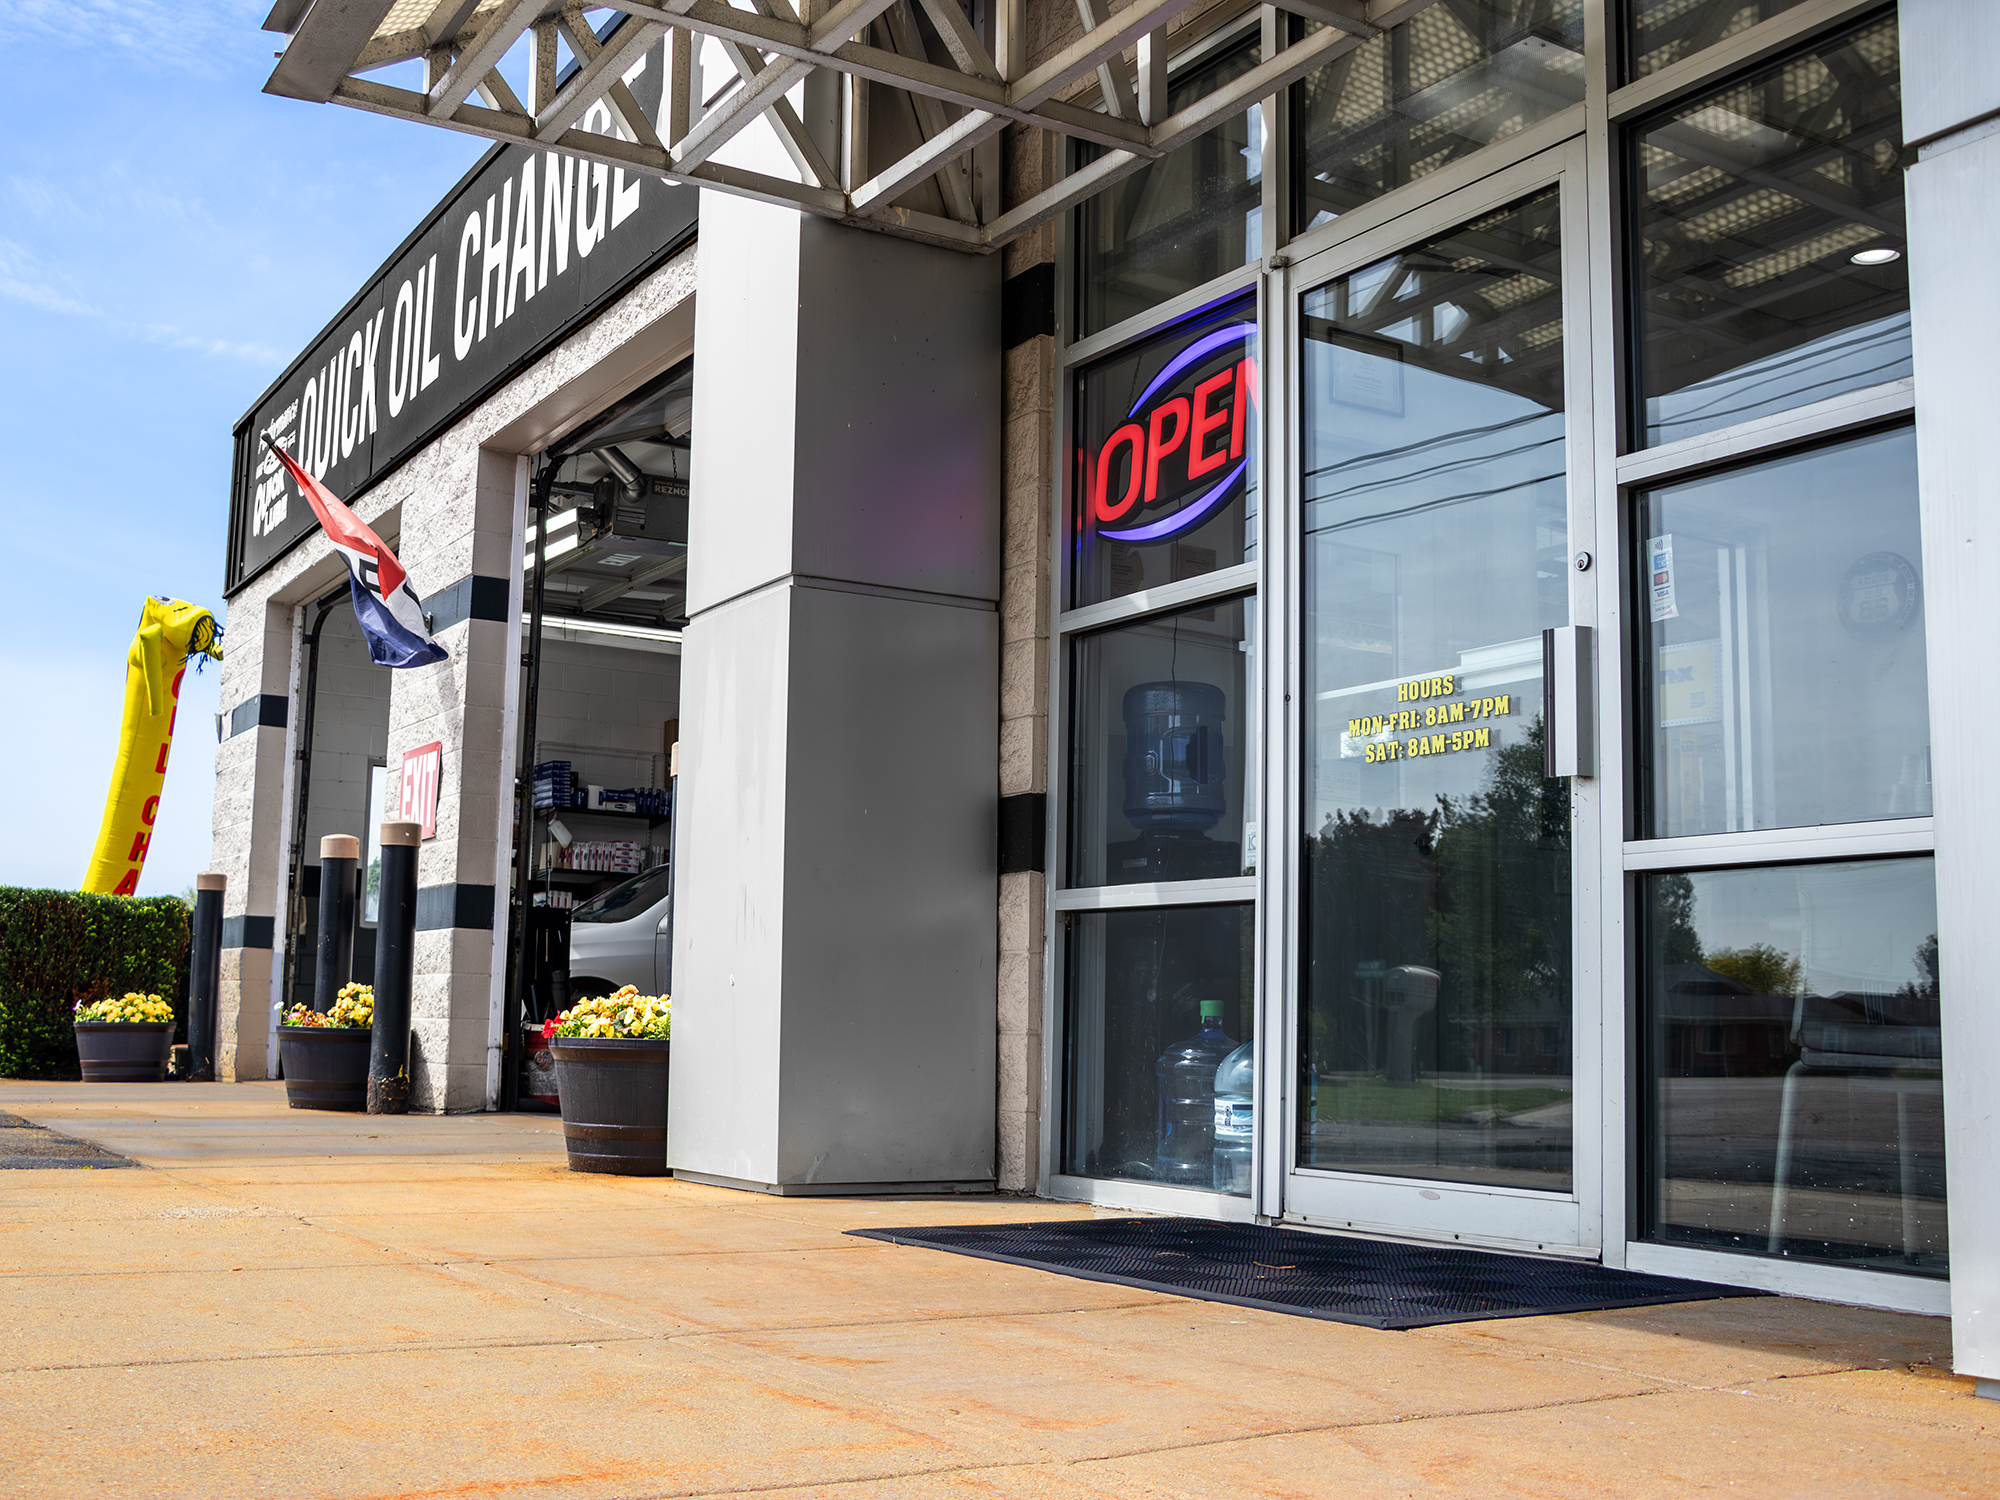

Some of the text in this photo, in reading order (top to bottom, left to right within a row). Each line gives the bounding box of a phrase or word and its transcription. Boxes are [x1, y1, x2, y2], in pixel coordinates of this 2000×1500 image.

[297, 306, 385, 498] QUICK
[388, 253, 441, 418] OIL
[654, 485, 690, 497] REZNO
[1397, 675, 1454, 702] HOURS
[1348, 694, 1510, 738] MON-FRI: 8AM-7PM
[1365, 727, 1490, 764] SAT: 8AM-5PM
[401, 750, 438, 828] EXIT
